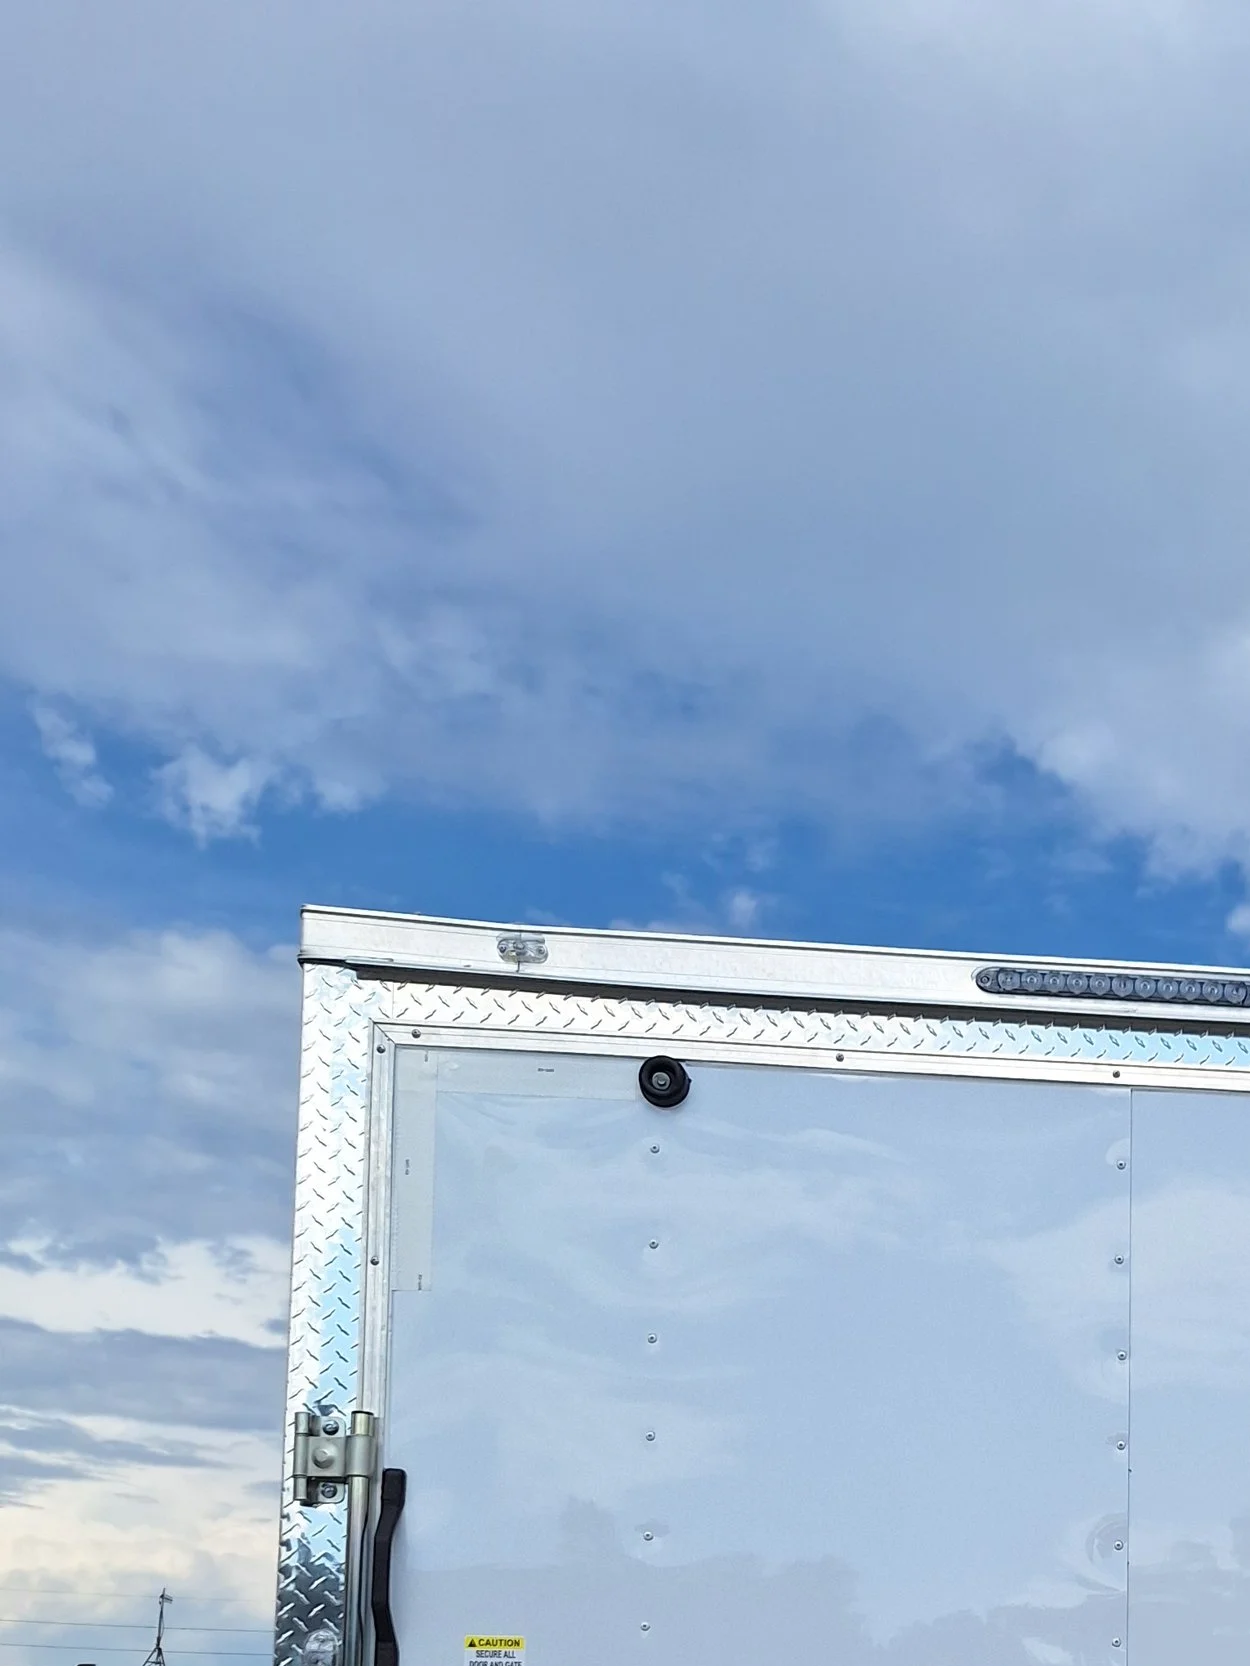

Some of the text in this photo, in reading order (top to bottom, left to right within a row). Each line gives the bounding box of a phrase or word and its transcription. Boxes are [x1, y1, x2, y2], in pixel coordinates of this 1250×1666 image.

[478, 1638, 521, 1647] CAUTION
[476, 1650, 516, 1659] SECURE ALL
